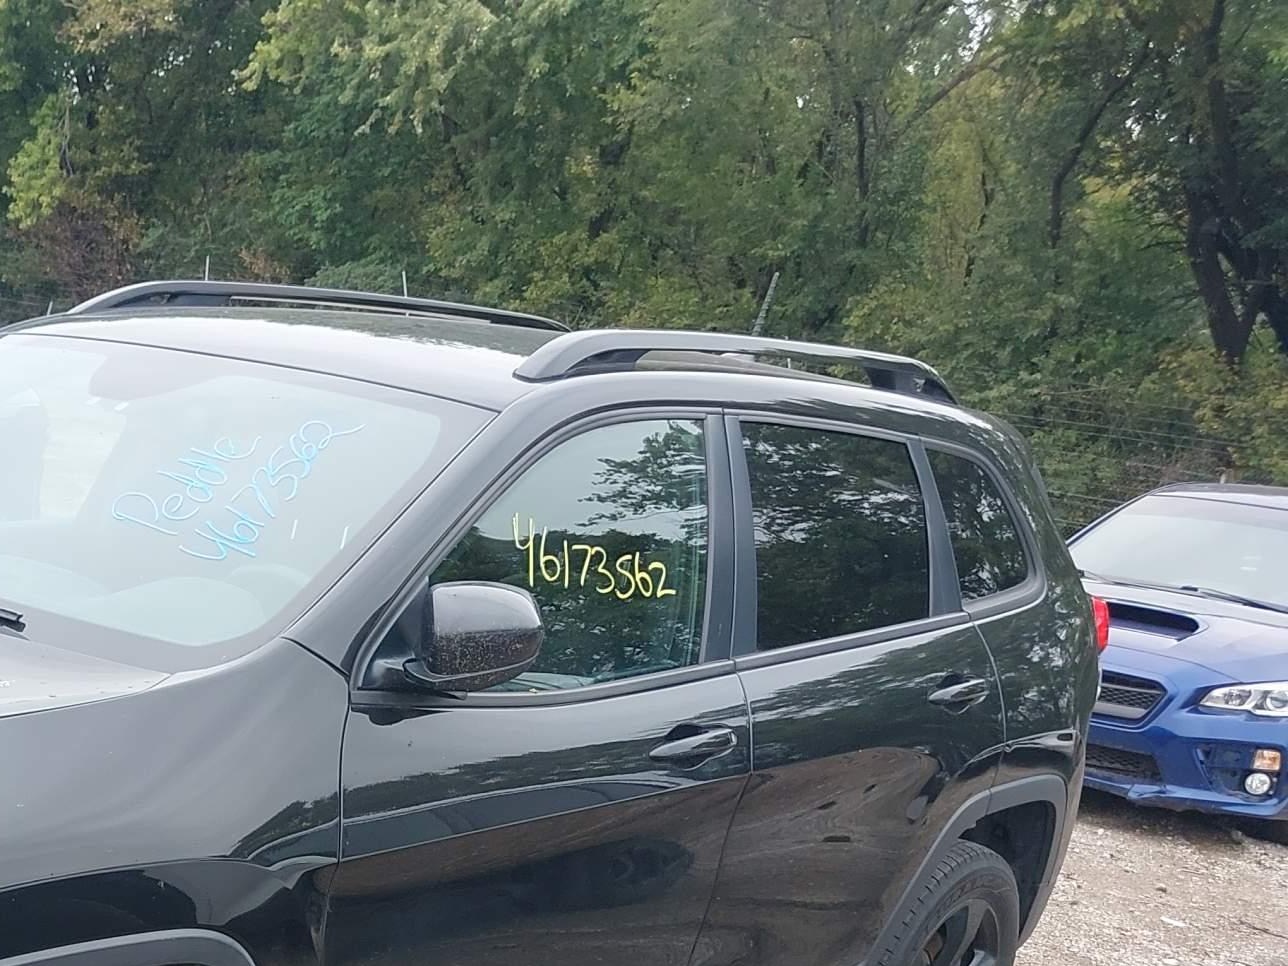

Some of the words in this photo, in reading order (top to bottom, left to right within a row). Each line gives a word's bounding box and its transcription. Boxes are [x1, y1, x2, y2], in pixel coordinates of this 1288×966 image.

[112, 436, 261, 536] Peddle
[178, 419, 366, 561] 46173562
[512, 512, 677, 600] 46173562
